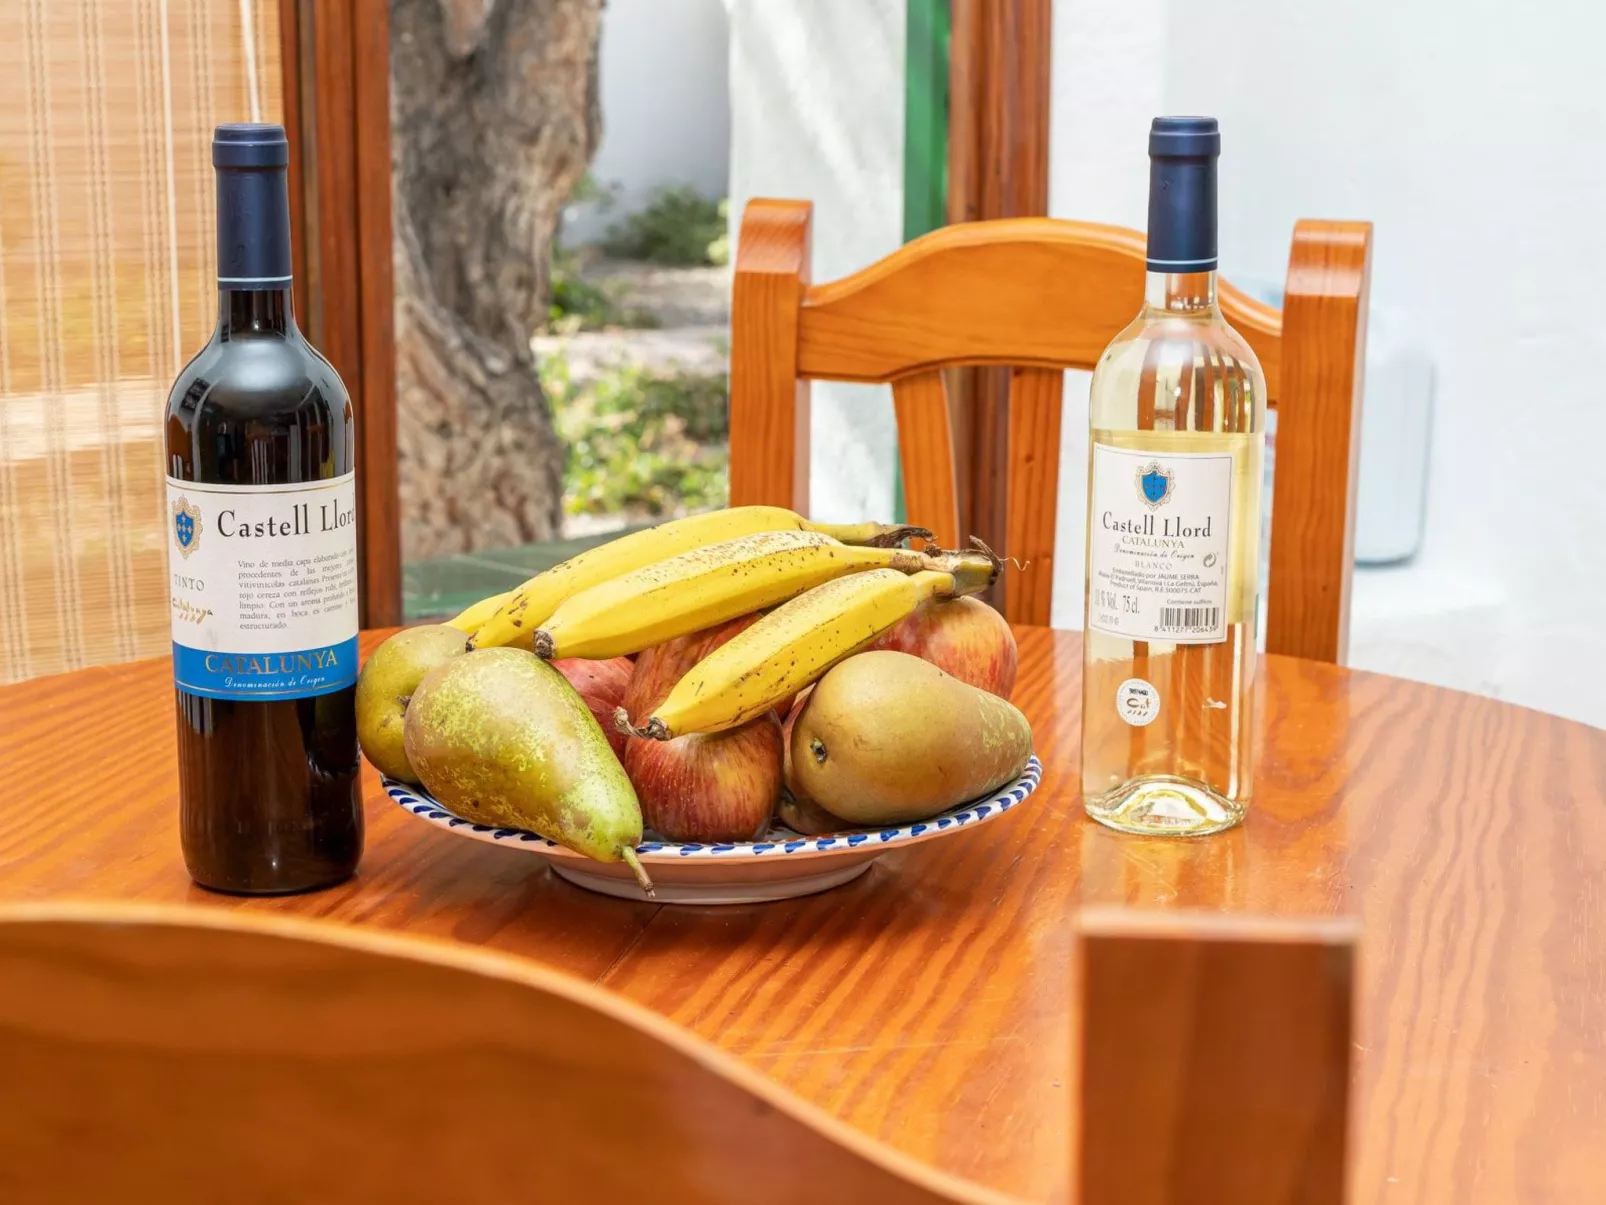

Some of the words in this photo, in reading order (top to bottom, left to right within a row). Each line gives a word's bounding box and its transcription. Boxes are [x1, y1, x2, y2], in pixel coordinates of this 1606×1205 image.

[217, 503, 310, 538] Castell
[1102, 511, 1154, 536] Castell
[1163, 516, 1211, 537] Llord
[1122, 535, 1185, 549] CATALUNYA
[1114, 543, 1158, 557] Denominación
[1160, 550, 1168, 558] de
[1171, 550, 1195, 561] Origen
[238, 560, 255, 568] Vino
[259, 560, 268, 568] de
[271, 559, 293, 567] media
[1134, 560, 1172, 570] BLANCO
[238, 570, 282, 579] procedentes
[174, 573, 205, 591] TINTO
[239, 592, 253, 600] rojo
[300, 598, 321, 606] aroma
[1123, 595, 1130, 612] 75
[205, 648, 338, 675] CATALUNYA
[224, 677, 284, 689] Denominación
[288, 676, 296, 687] de
[300, 675, 325, 688] Origen
